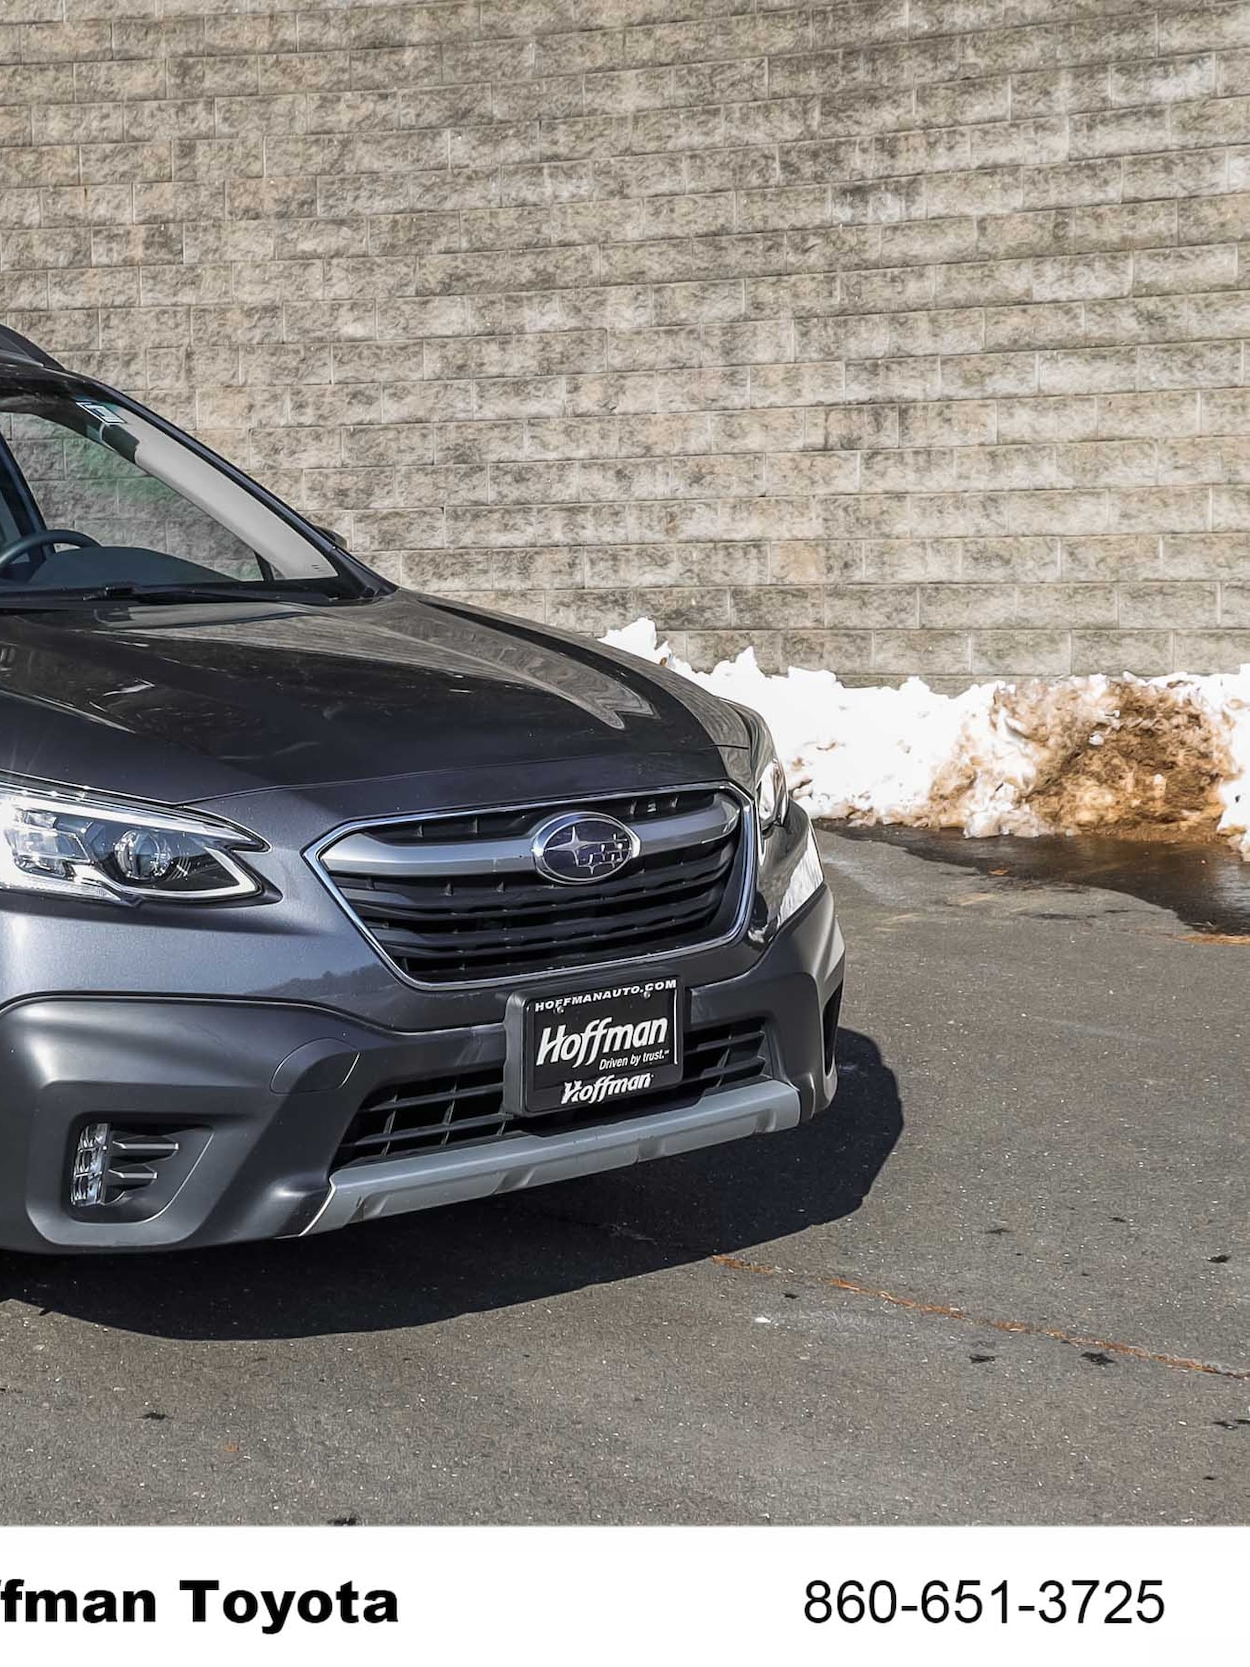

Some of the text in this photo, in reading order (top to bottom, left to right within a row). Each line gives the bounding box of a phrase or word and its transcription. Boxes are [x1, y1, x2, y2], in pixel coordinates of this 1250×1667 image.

[535, 979, 677, 1012] HOFFMANAUTO.COM
[536, 1017, 668, 1068] Hoffman
[599, 1057, 628, 1071] Driven
[630, 1054, 642, 1067] by
[561, 1072, 652, 1104] Hoffman
